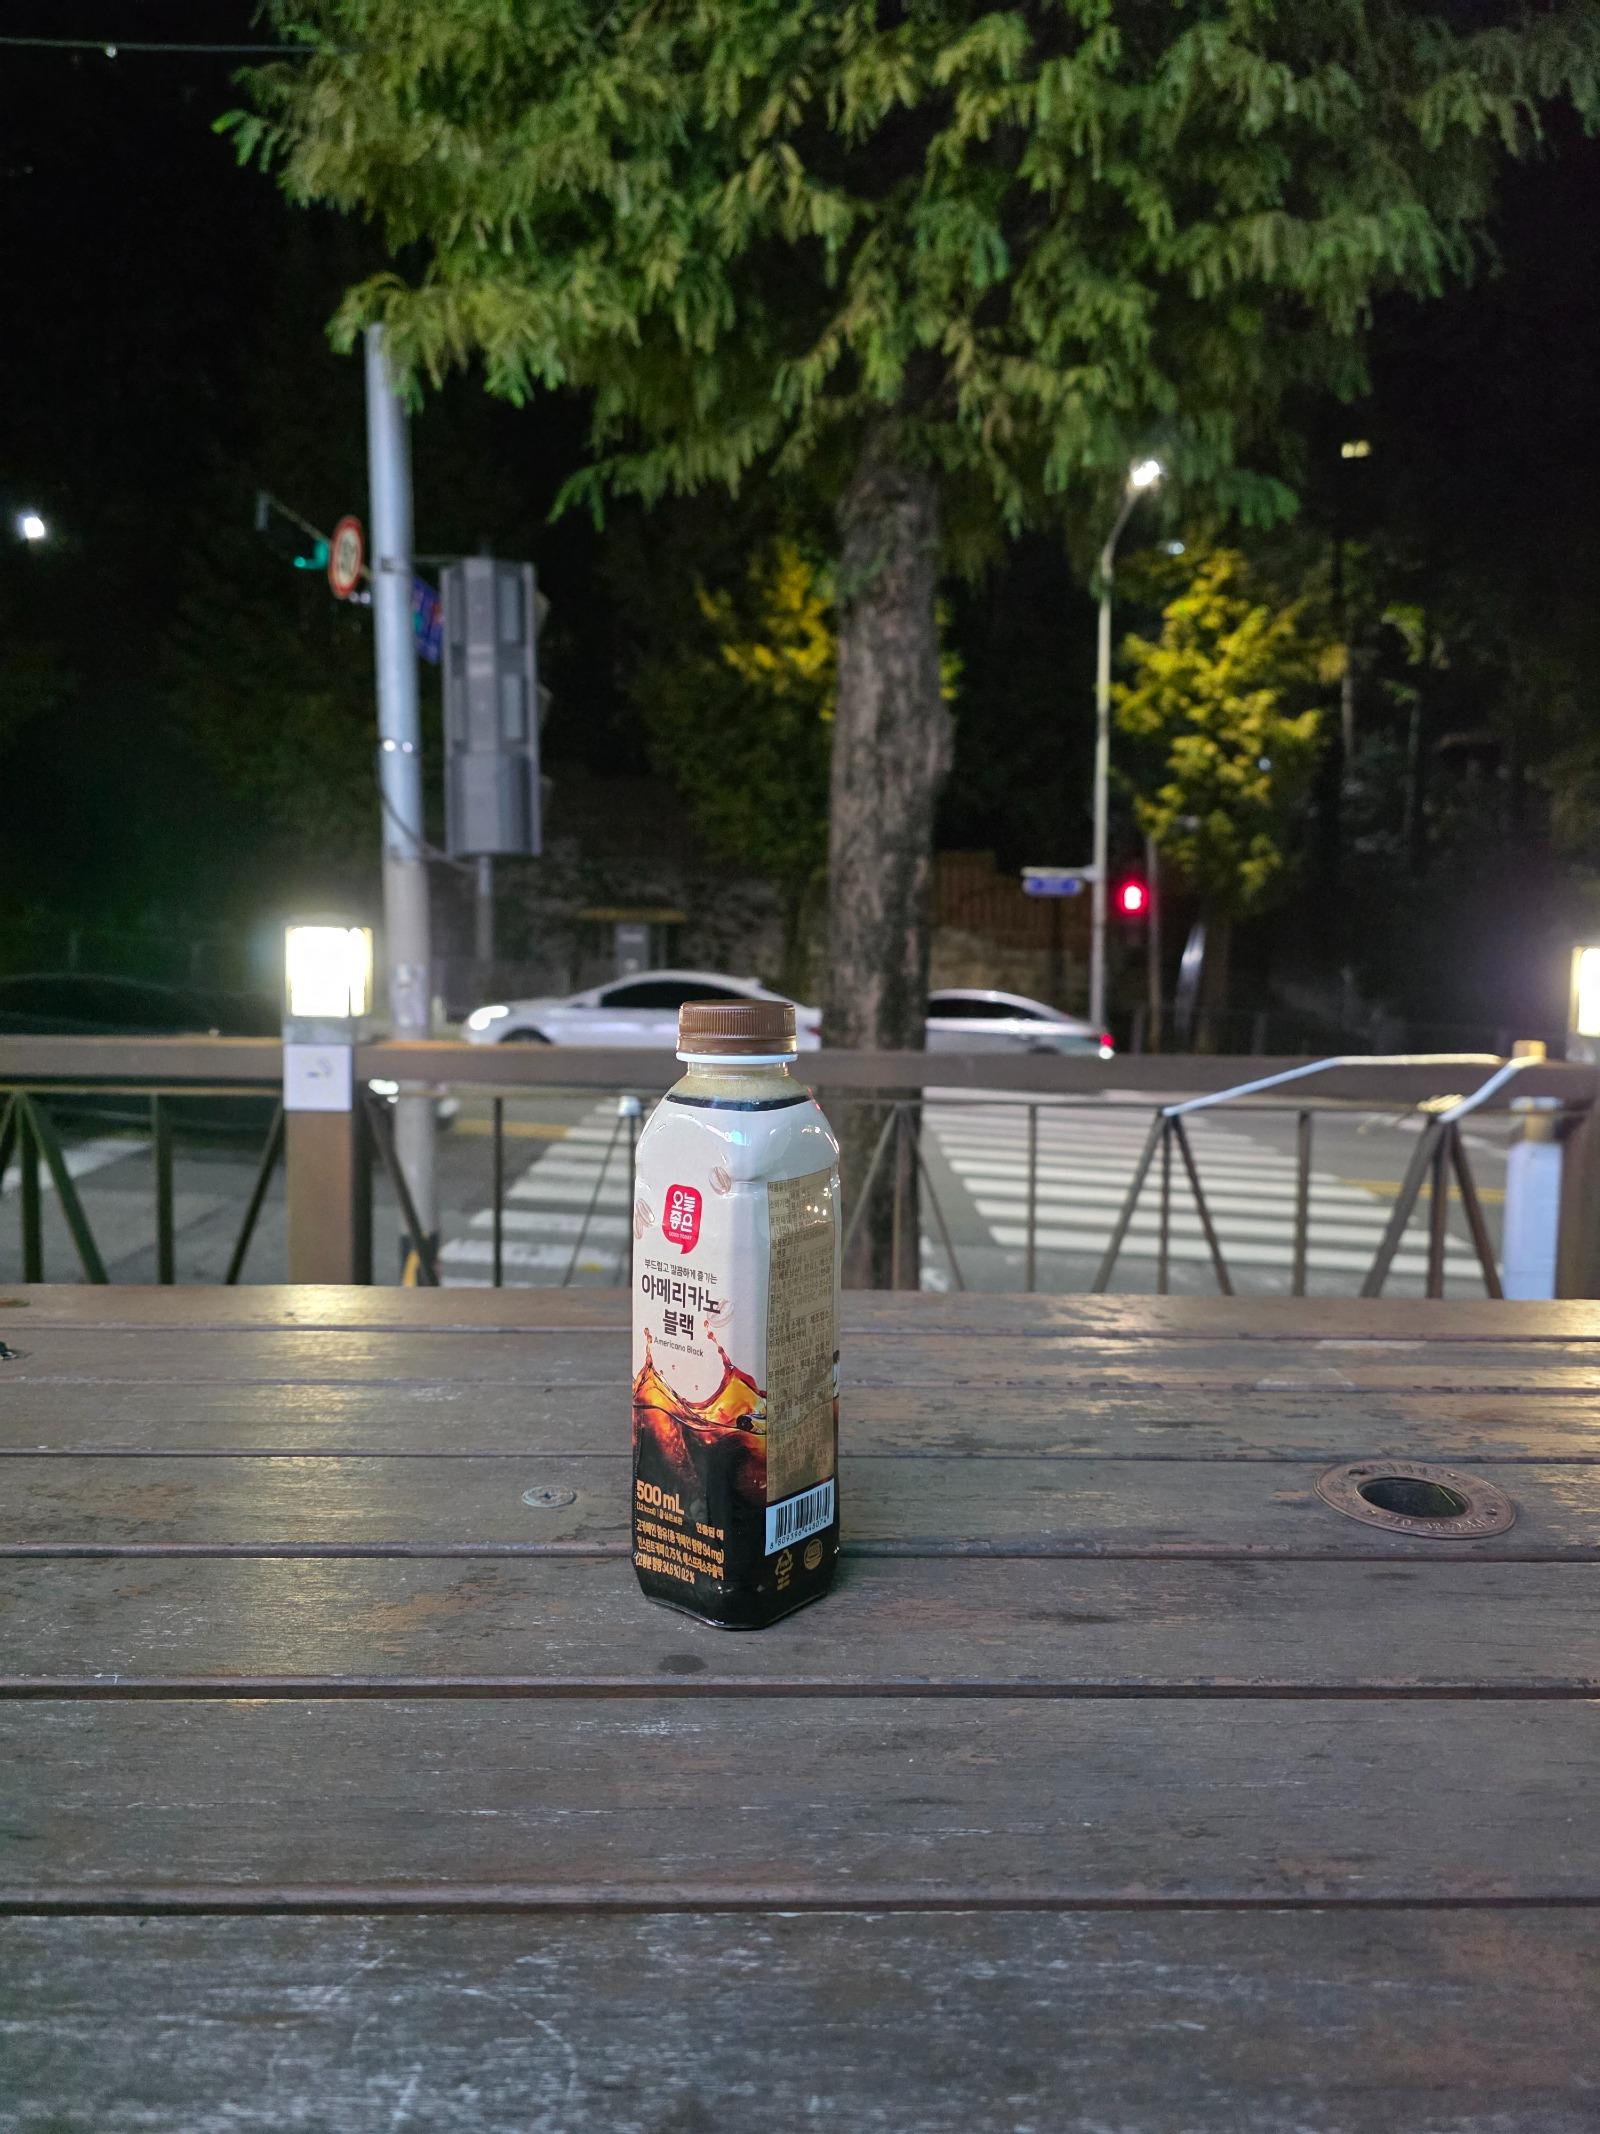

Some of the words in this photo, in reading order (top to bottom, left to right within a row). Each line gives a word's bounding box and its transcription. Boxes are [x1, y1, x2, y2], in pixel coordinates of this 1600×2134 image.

[672, 1190, 696, 1213] 오늘
[669, 1210, 693, 1233] 좋은
[644, 1258, 670, 1273] 부드럽고
[670, 1264, 696, 1280] 깔끔하게
[696, 1270, 718, 1285] 즐기는
[641, 1274, 721, 1315] 아메리카노
[662, 1308, 694, 1341] 블랙
[654, 1336, 686, 1352] Americano
[686, 1345, 704, 1358] Black
[636, 1479, 662, 1506] 500
[662, 1492, 685, 1515] mL
[636, 1518, 657, 1536] 고카페인
[675, 1532, 692, 1551] 카페인
[691, 1538, 703, 1556] 함량
